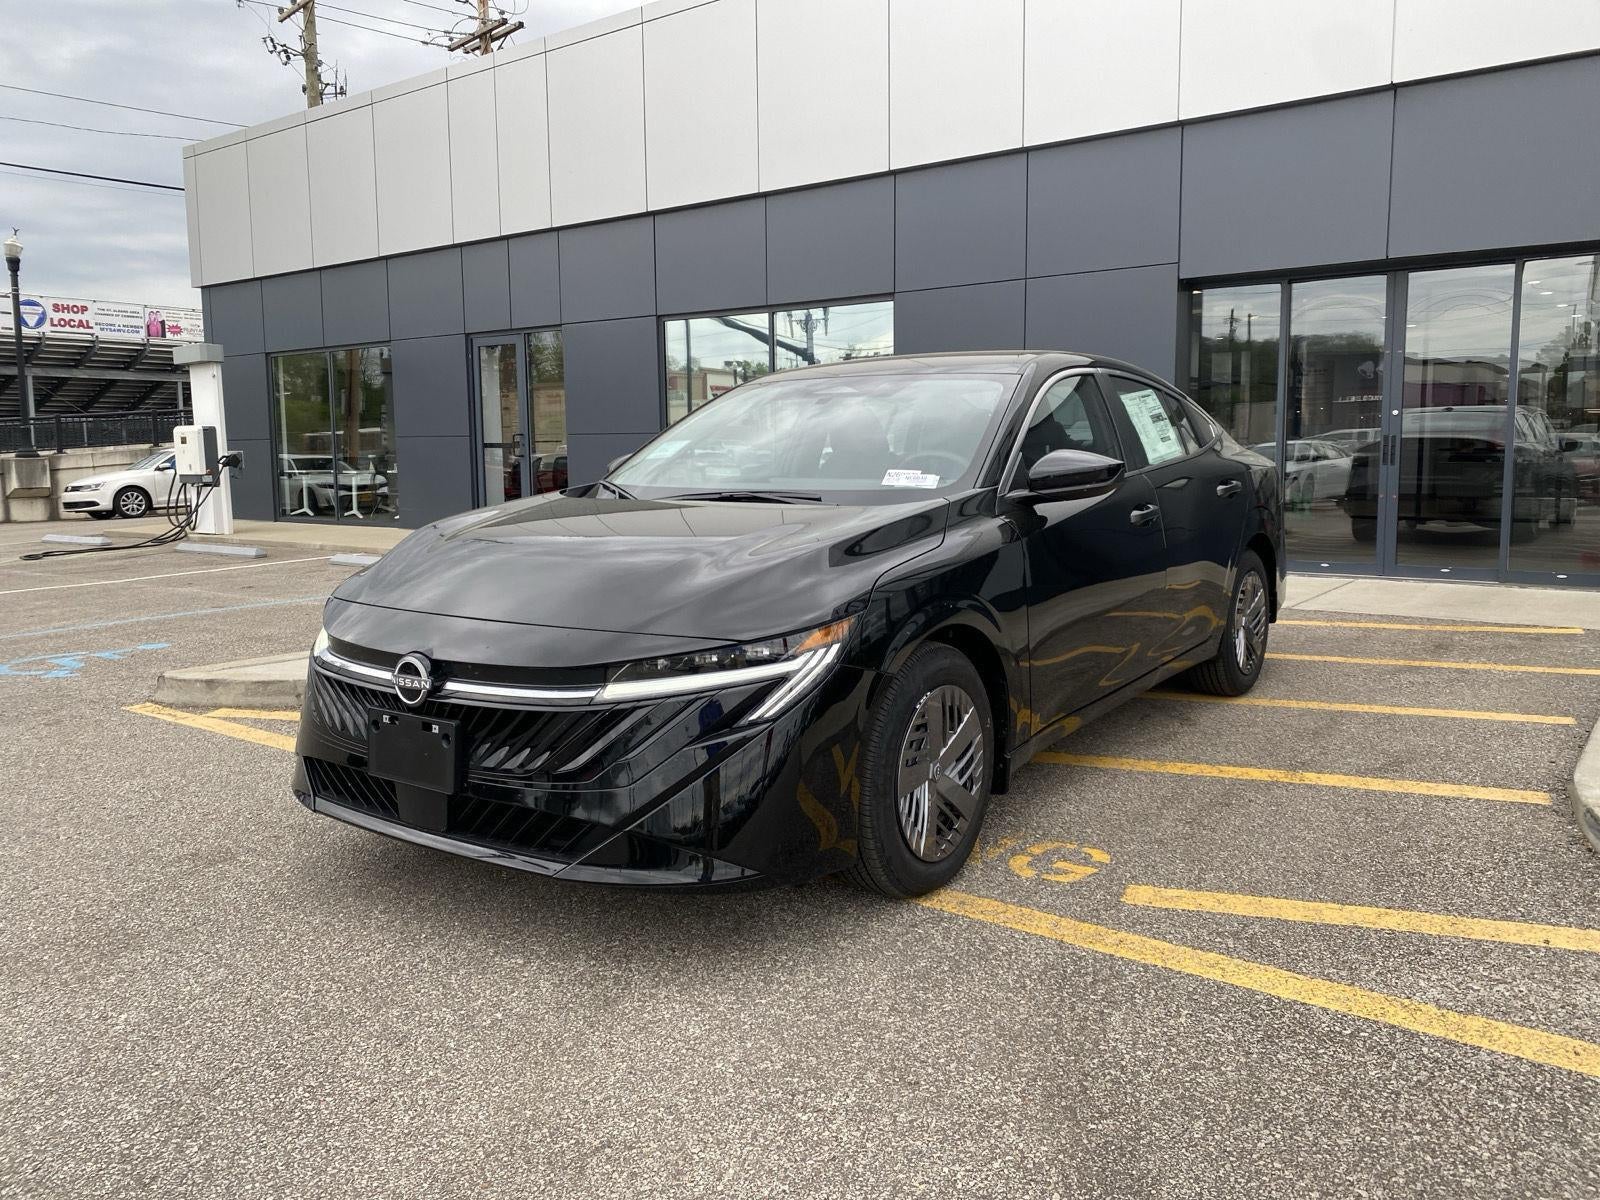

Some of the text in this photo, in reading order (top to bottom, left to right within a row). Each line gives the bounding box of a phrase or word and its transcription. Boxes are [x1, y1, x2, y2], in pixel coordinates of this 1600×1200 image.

[52, 303, 89, 314] SHOP
[50, 317, 94, 329] LOCAL
[391, 675, 430, 689] NISSAN
